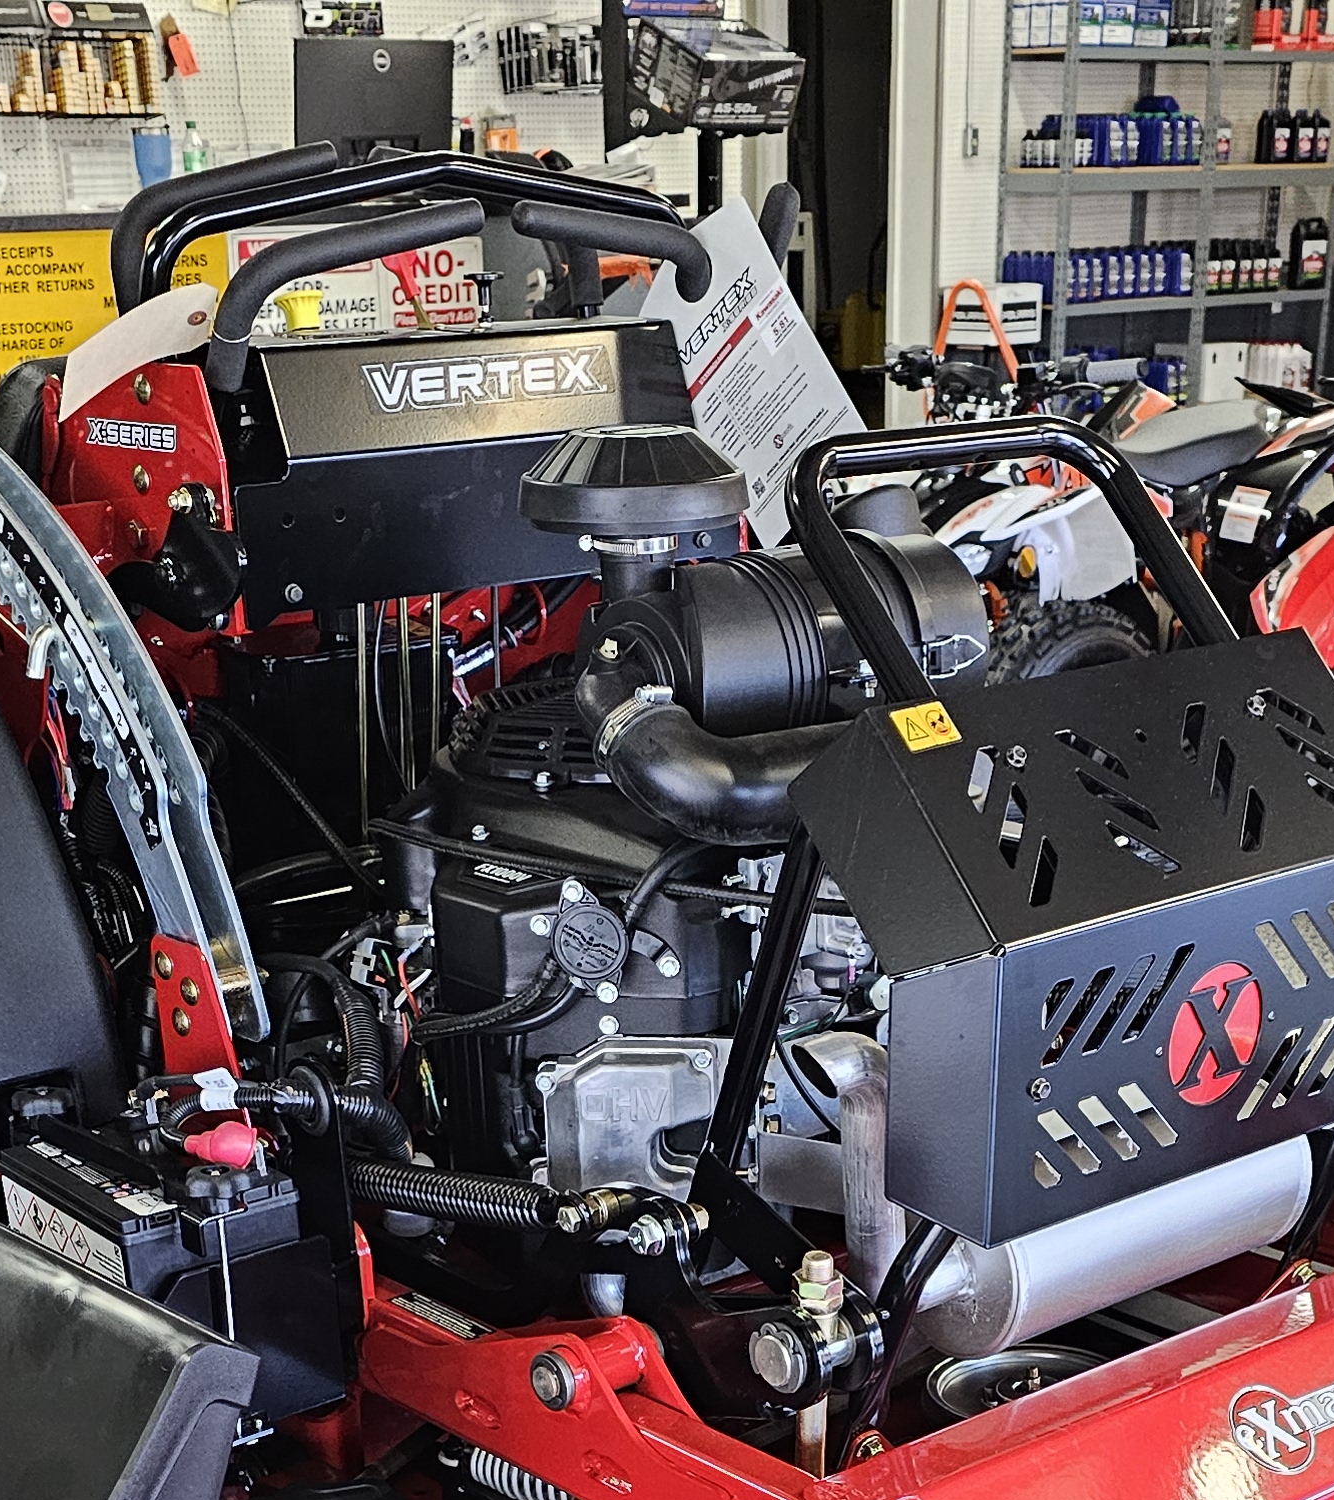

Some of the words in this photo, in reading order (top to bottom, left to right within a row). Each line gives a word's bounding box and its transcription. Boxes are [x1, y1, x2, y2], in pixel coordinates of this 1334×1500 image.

[5, 261, 85, 276] ACCOMPANY
[37, 277, 95, 292] RETURNS
[678, 265, 751, 366] VERTEX
[49, 336, 65, 349] OF
[362, 345, 608, 413] VERTEX
[86, 416, 177, 452] X-SERIES
[580, 1086, 668, 1122] OHV
